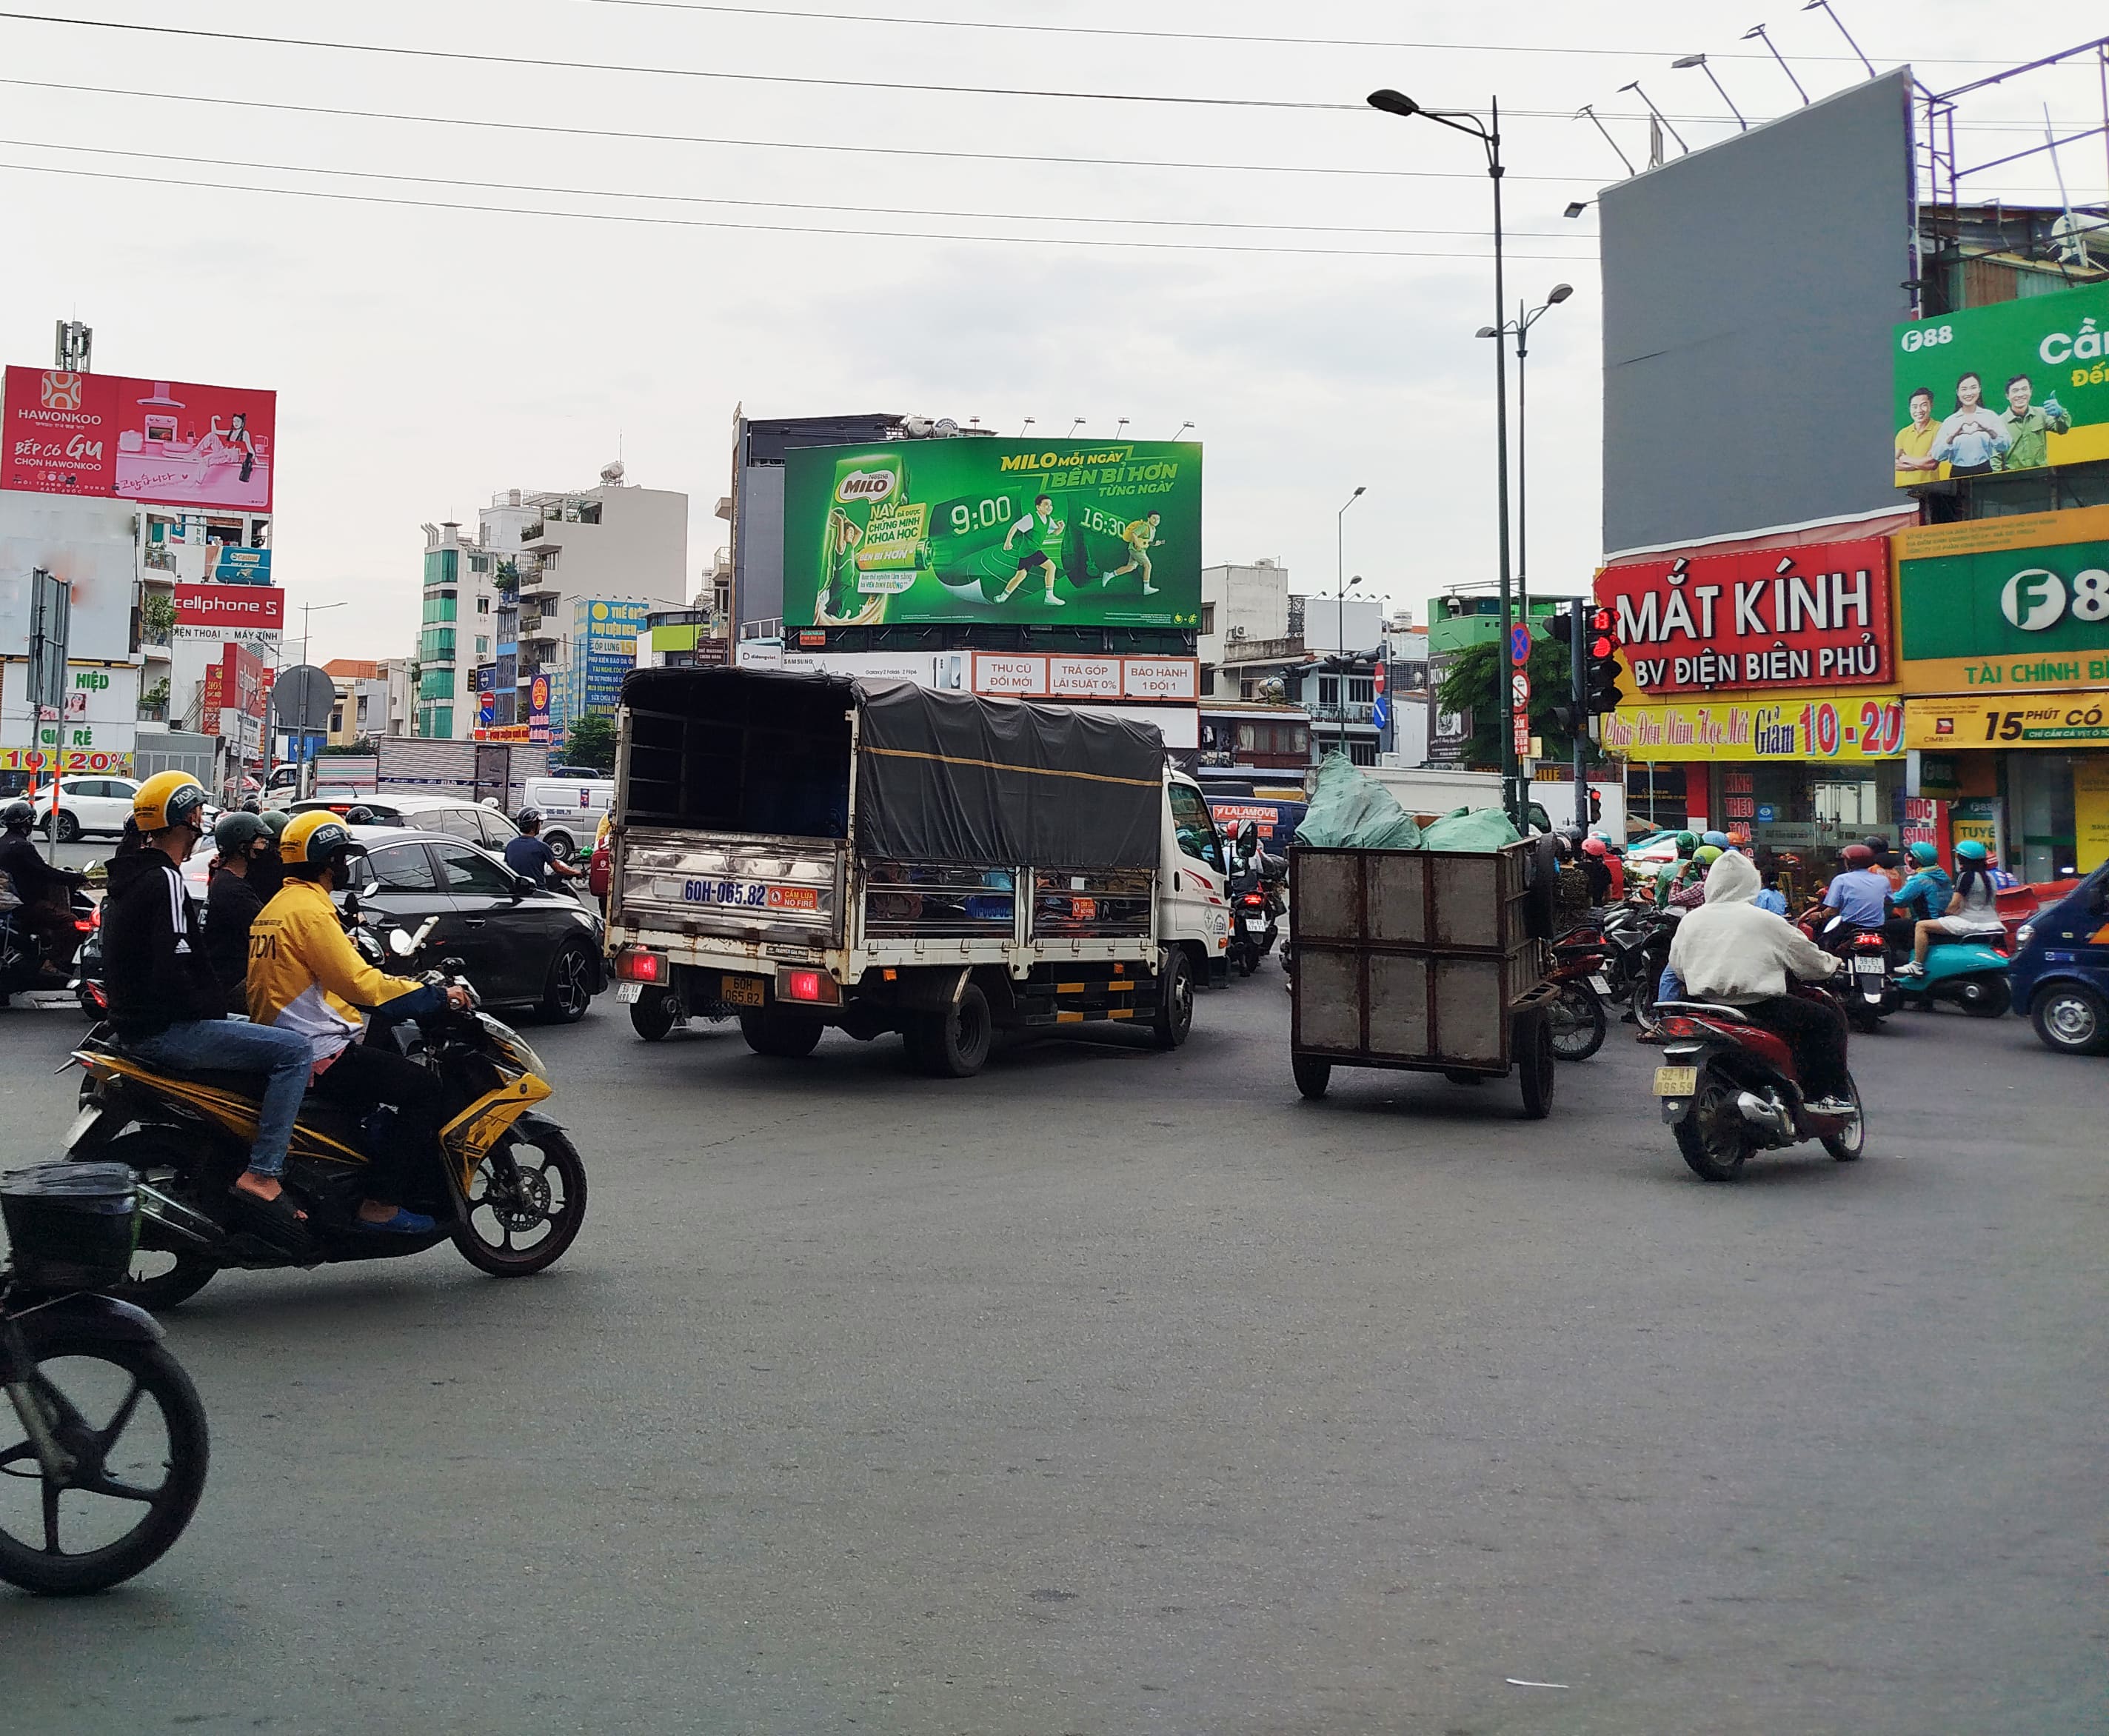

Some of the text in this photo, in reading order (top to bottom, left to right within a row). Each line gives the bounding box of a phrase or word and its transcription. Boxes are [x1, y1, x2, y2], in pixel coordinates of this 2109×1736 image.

[1901, 324, 1953, 353] F88
[2039, 317, 2109, 364] Cầ
[2071, 361, 2109, 387] Đế
[18, 409, 101, 425] HAWONKOO
[45, 460, 101, 470] HAWONKOO
[1000, 451, 1124, 471] MILO MỖI NGÀY
[1049, 461, 1178, 487] BỀN BỈ HƠN
[844, 480, 888, 494] MILO
[1098, 481, 1174, 497] TỪNG NGÀY
[871, 501, 900, 521] NAY
[951, 495, 1012, 535] 9:00
[869, 516, 920, 533] CHỨNG MINH
[1080, 507, 1126, 538] 16:30
[867, 527, 918, 544] KHOA HỌC
[174, 595, 260, 614] cellphone
[1617, 557, 1871, 644] MẮT KÍNH
[194, 629, 221, 639] THOẠI
[234, 629, 254, 639] MÁY
[991, 663, 1032, 674] THU CŨ
[1061, 664, 1109, 675] TRẢ GÓP
[1634, 632, 1876, 690] BV ĐIỆN BIÊN PHỦ
[1131, 666, 1188, 678] BẢO HÀNH
[1964, 661, 2002, 684] TÀI
[2011, 658, 2079, 684] CHÍNH
[989, 675, 1032, 687] ĐỔI MỚI
[1053, 677, 1117, 690] LÃI SUẤT 0%
[1142, 678, 1176, 691] 1 ĐỔI 1
[1754, 706, 1795, 755] Giảm
[1799, 703, 1839, 756] 10
[1985, 704, 2103, 741] 15 PHÚT CÓ
[73, 726, 93, 747] RẺ
[1225, 807, 1277, 818] LALAMOVE
[1724, 798, 1754, 818] THEO
[1905, 798, 1933, 827] HỌC
[685, 880, 766, 907] 60H-065.82
[784, 889, 814, 900] CẤM LỬA
[784, 899, 814, 908] NO FIRE
[733, 978, 752, 990] 60H
[725, 989, 760, 1005] 065.82
